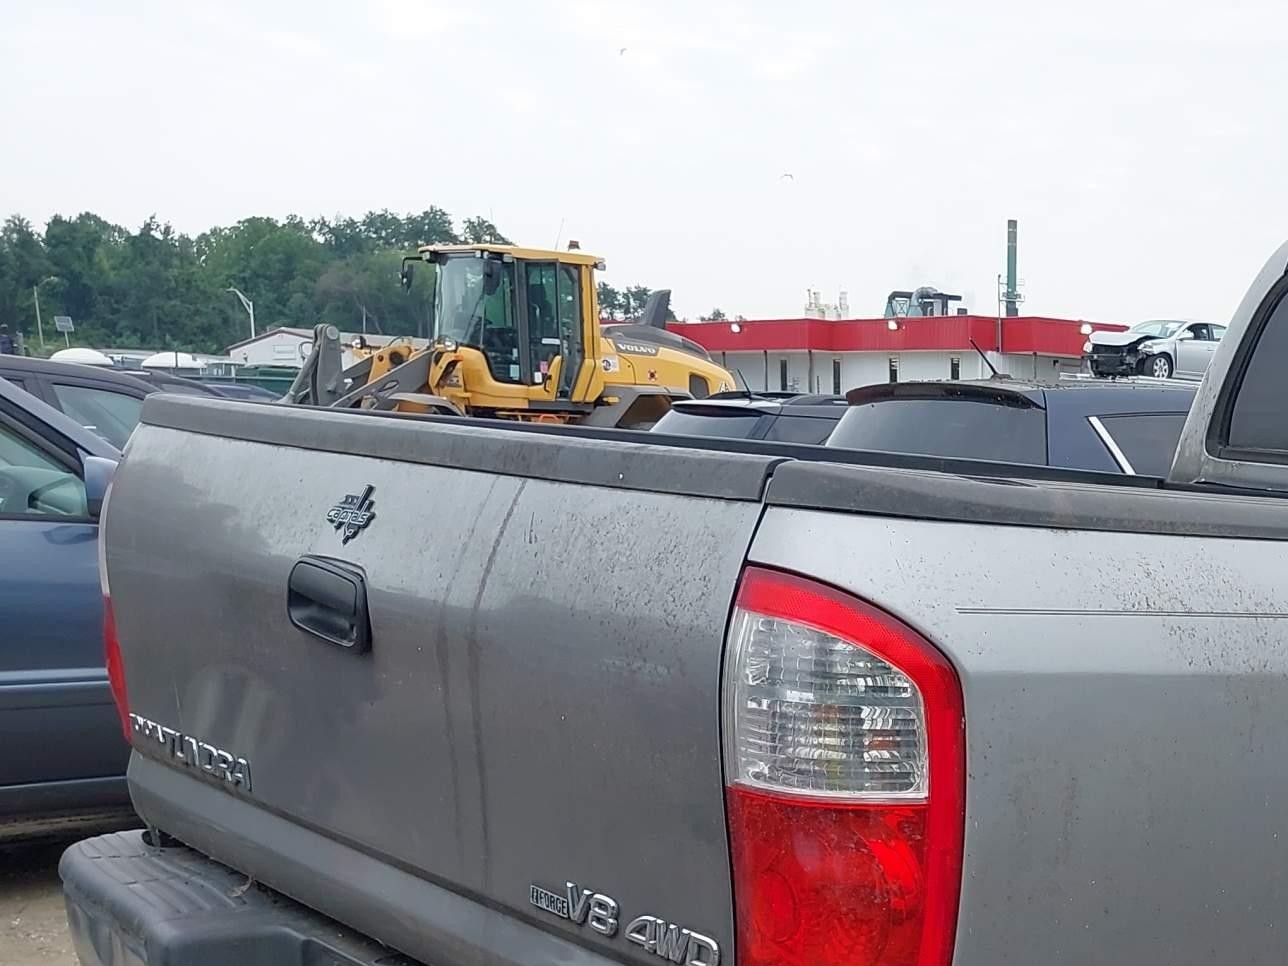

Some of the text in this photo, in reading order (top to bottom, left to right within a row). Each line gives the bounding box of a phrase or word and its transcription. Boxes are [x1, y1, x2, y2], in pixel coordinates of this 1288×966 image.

[616, 343, 657, 354] VOLVO
[128, 713, 253, 792] TUNDRA
[566, 881, 620, 937] V8
